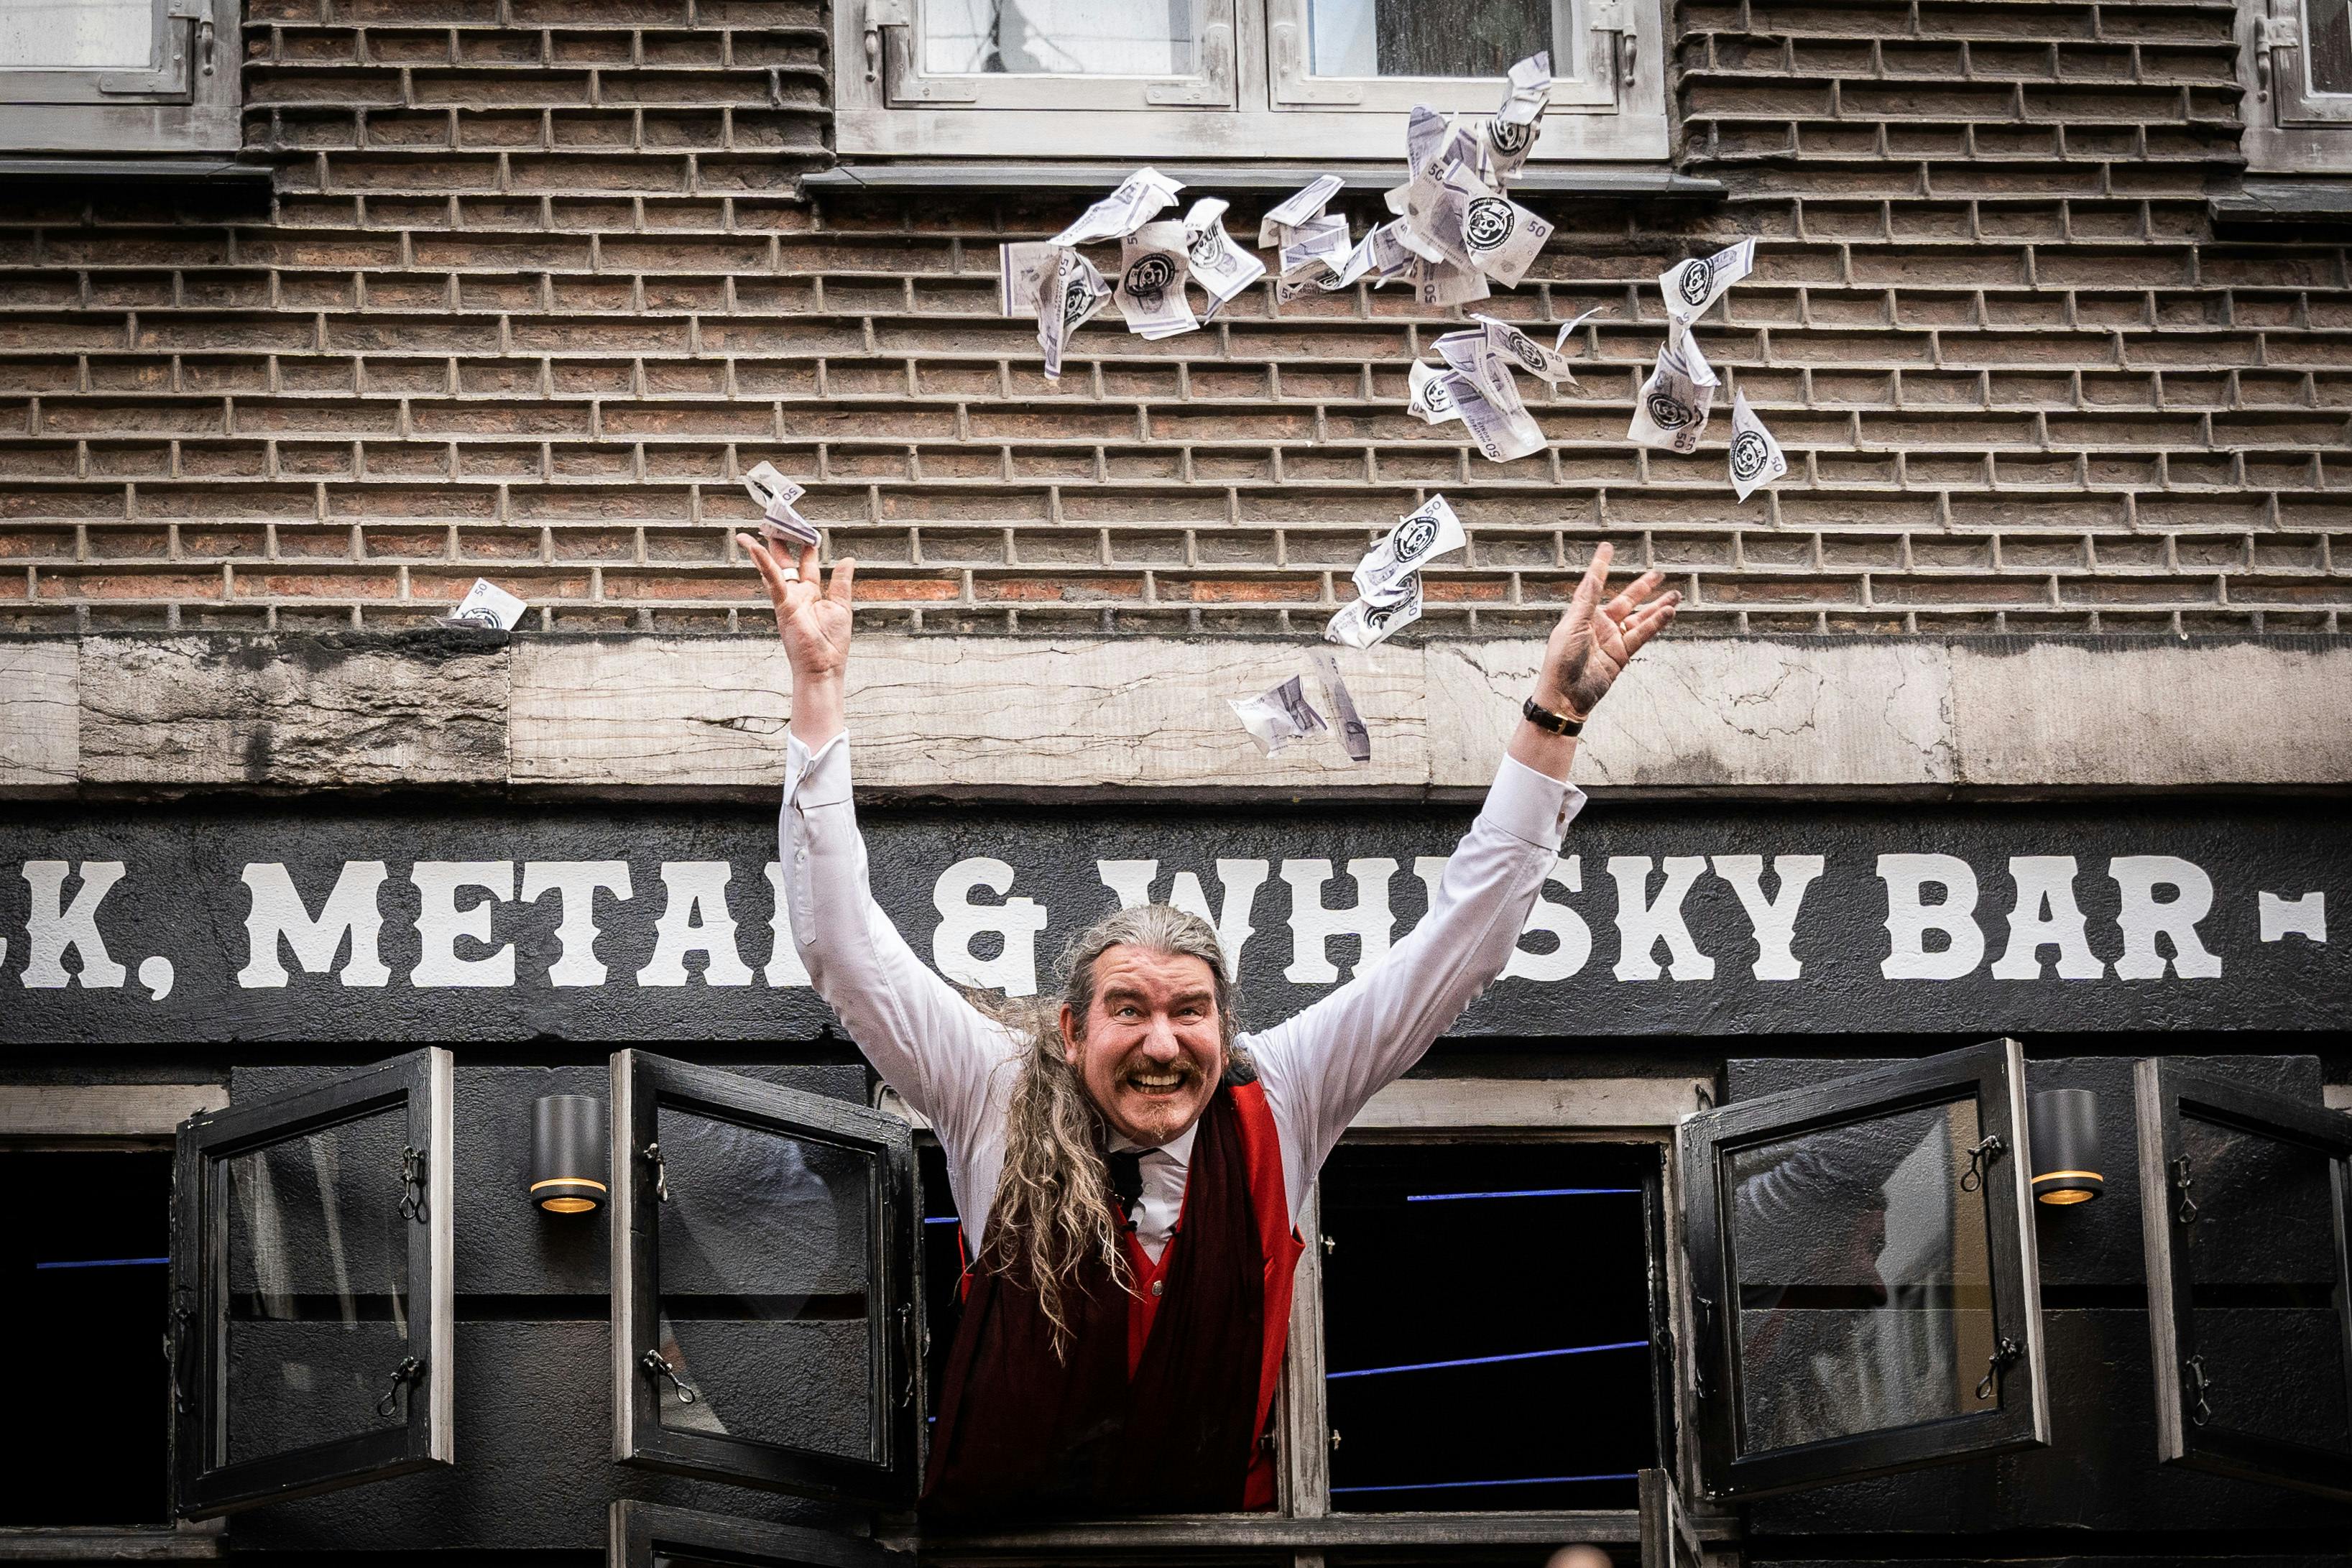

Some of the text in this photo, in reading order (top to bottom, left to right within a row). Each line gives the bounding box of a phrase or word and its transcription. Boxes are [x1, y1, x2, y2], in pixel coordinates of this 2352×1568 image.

[1428, 163, 1444, 181] 50
[1526, 221, 1546, 237] 50
[1059, 258, 1069, 277] 50
[1424, 285, 1436, 303] 50
[1674, 432, 1687, 448] 50
[1485, 443, 1500, 458] 50
[1771, 456, 1783, 472] 50
[783, 487, 798, 501] 50
[1425, 501, 1441, 517] 50
[474, 583, 487, 596] 50
[1408, 600, 1419, 617] 50
[0, 860, 175, 1001] K,
[933, 857, 1047, 997] &
[1876, 854, 2222, 980] BAR
